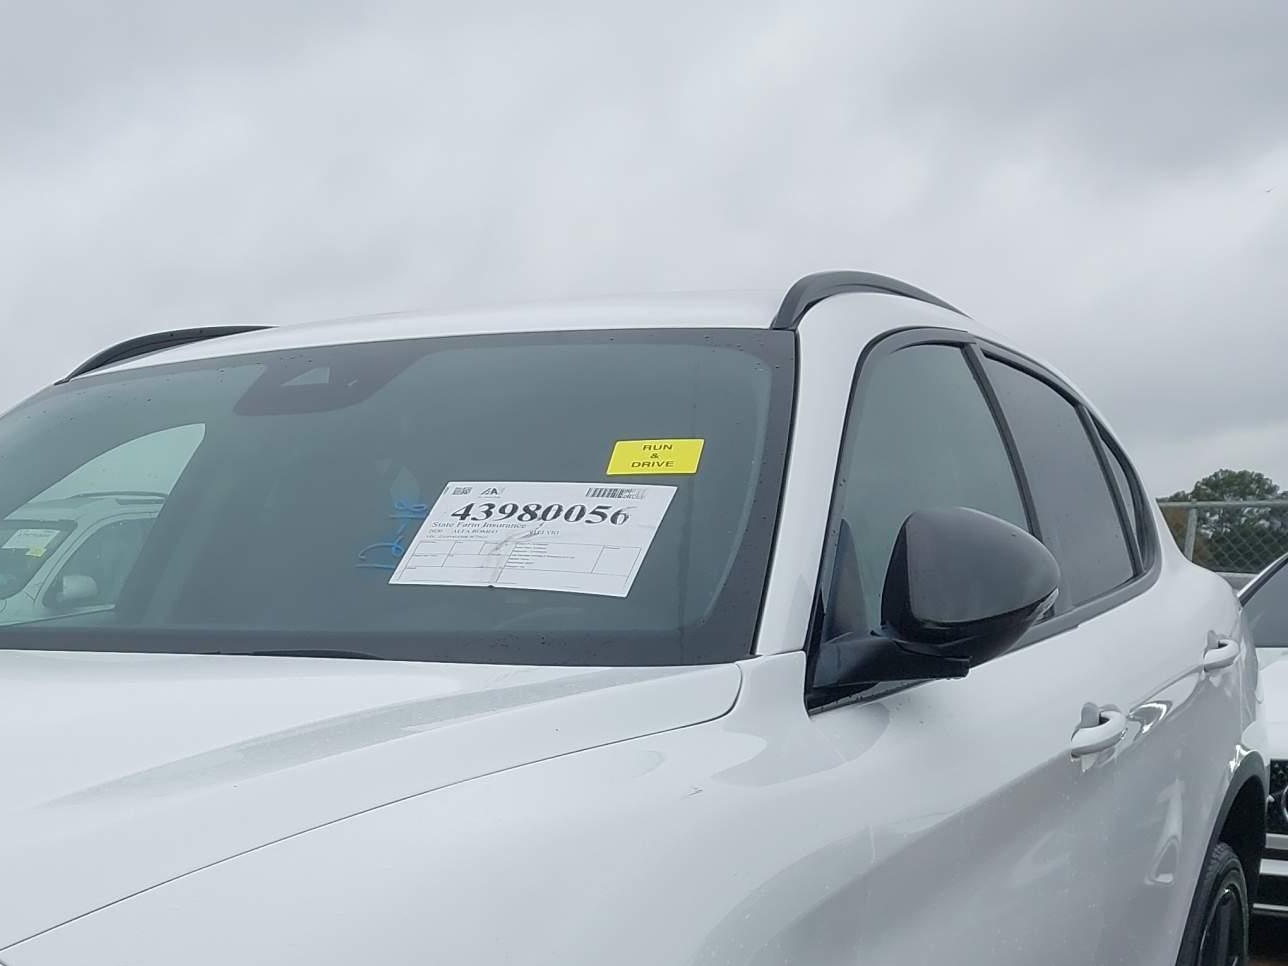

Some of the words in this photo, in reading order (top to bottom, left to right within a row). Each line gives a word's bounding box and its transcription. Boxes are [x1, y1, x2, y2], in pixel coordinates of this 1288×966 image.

[631, 460, 675, 468] DRIVE
[450, 502, 631, 526] 43980056
[481, 521, 527, 529] Insurance
